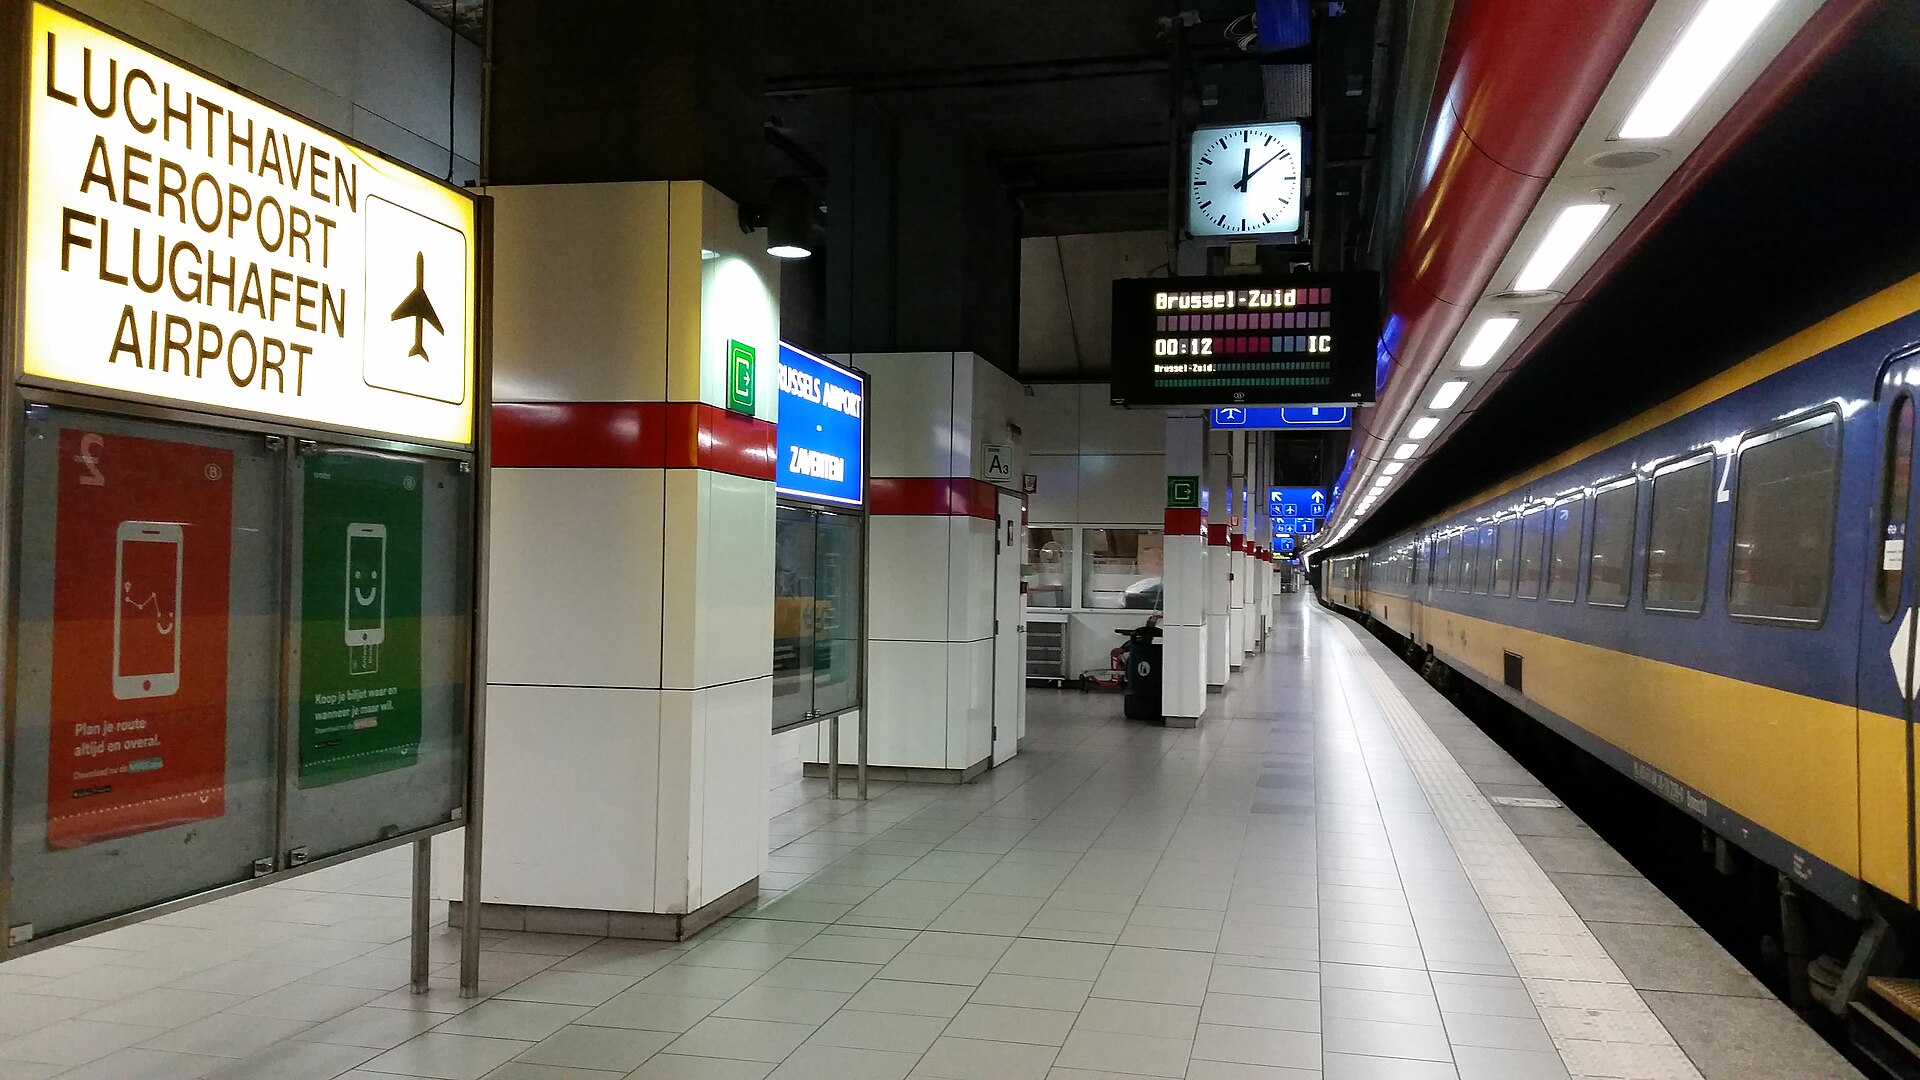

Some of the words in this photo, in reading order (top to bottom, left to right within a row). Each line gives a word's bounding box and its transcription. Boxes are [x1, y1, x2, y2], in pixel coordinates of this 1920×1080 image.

[46, 32, 357, 213] LUCHTHAVEN
[80, 134, 337, 269] AEROPORT
[61, 206, 346, 338] FLUGHAFEN
[1155, 288, 1296, 309] Brussel-Zuid
[108, 304, 313, 397] AIRPORT
[1154, 337, 1213, 356] 00:12
[1308, 335, 1331, 353] IC
[822, 382, 861, 418] AIRPORT
[789, 445, 845, 482] ZAVENTEM
[315, 694, 337, 705] Koop
[338, 691, 345, 704] je
[74, 741, 104, 757] altijd
[107, 742, 120, 752] en
[124, 734, 161, 750] overal.
[75, 722, 101, 737] Plan
[103, 720, 114, 736] je
[116, 718, 146, 731] route
